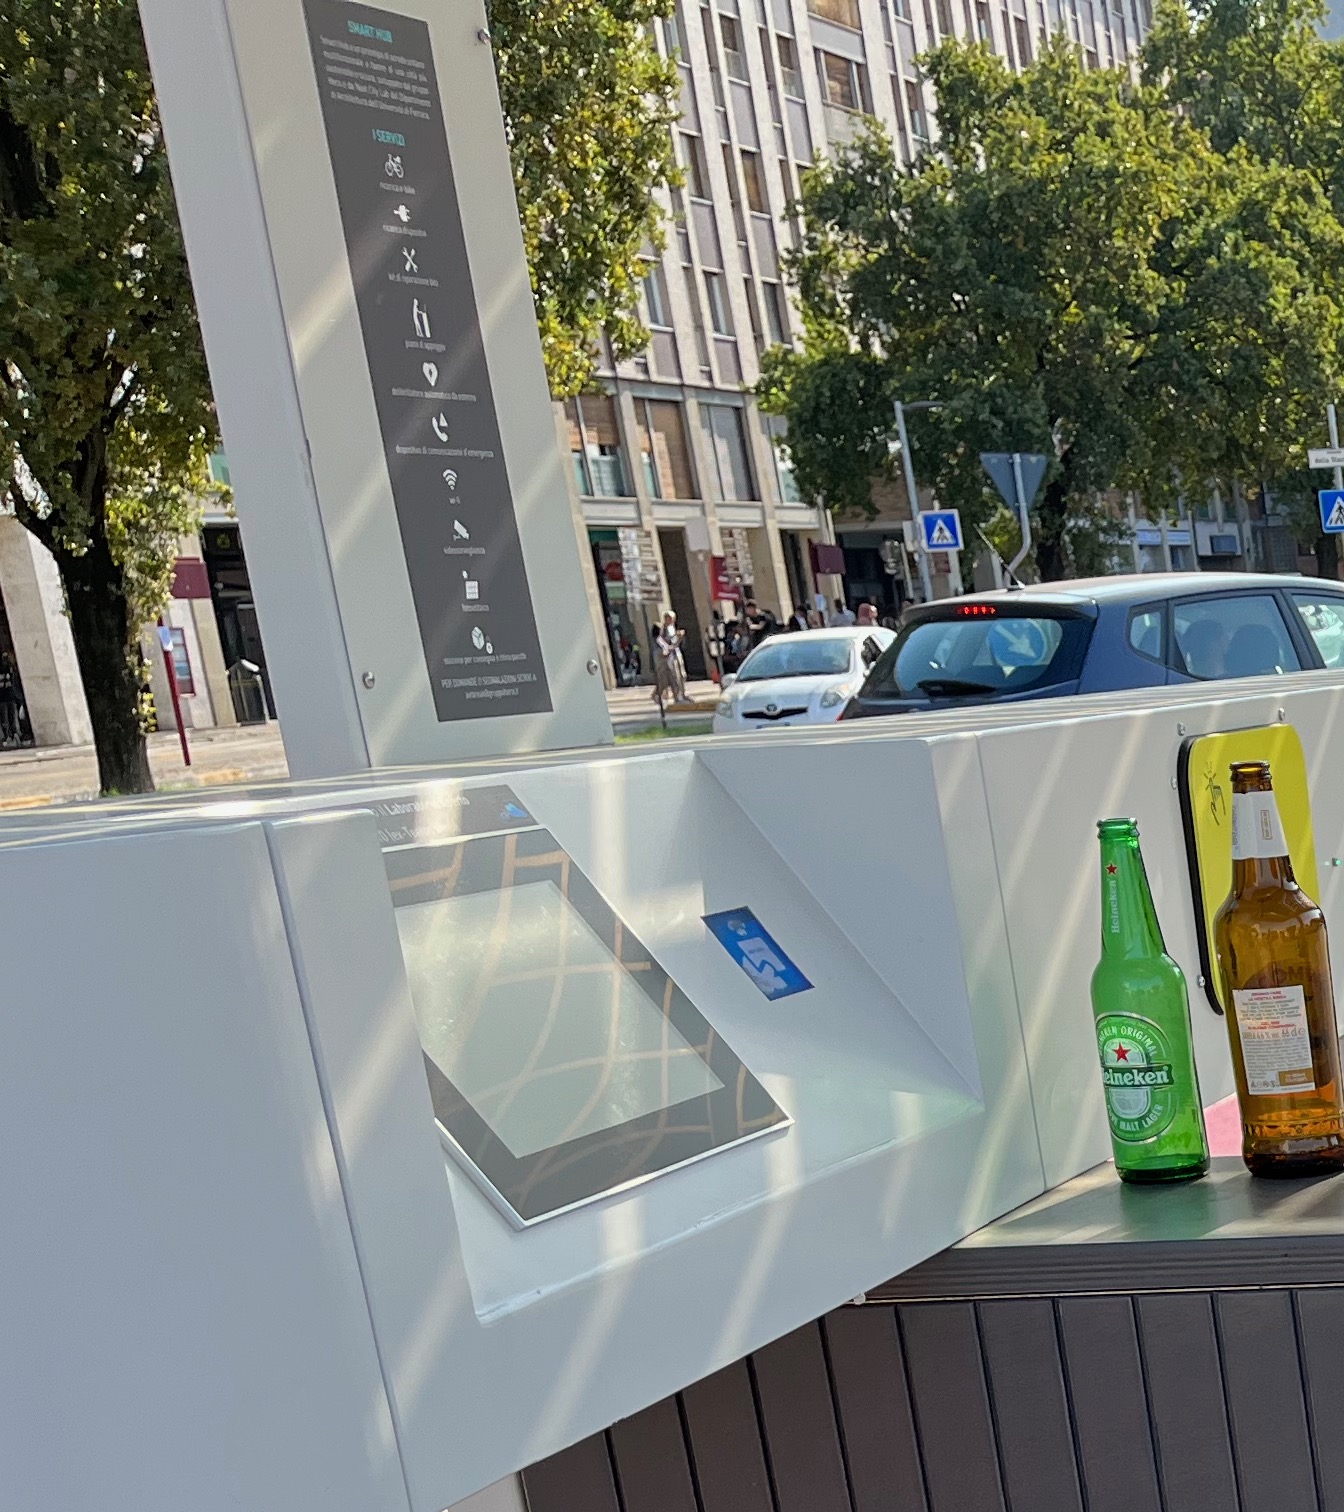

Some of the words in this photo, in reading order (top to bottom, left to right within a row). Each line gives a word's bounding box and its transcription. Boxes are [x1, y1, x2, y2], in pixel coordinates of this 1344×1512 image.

[1111, 879, 1121, 934] Heineken
[1120, 1026, 1157, 1058] ORIGINAL
[1142, 1104, 1163, 1128] LAGER
